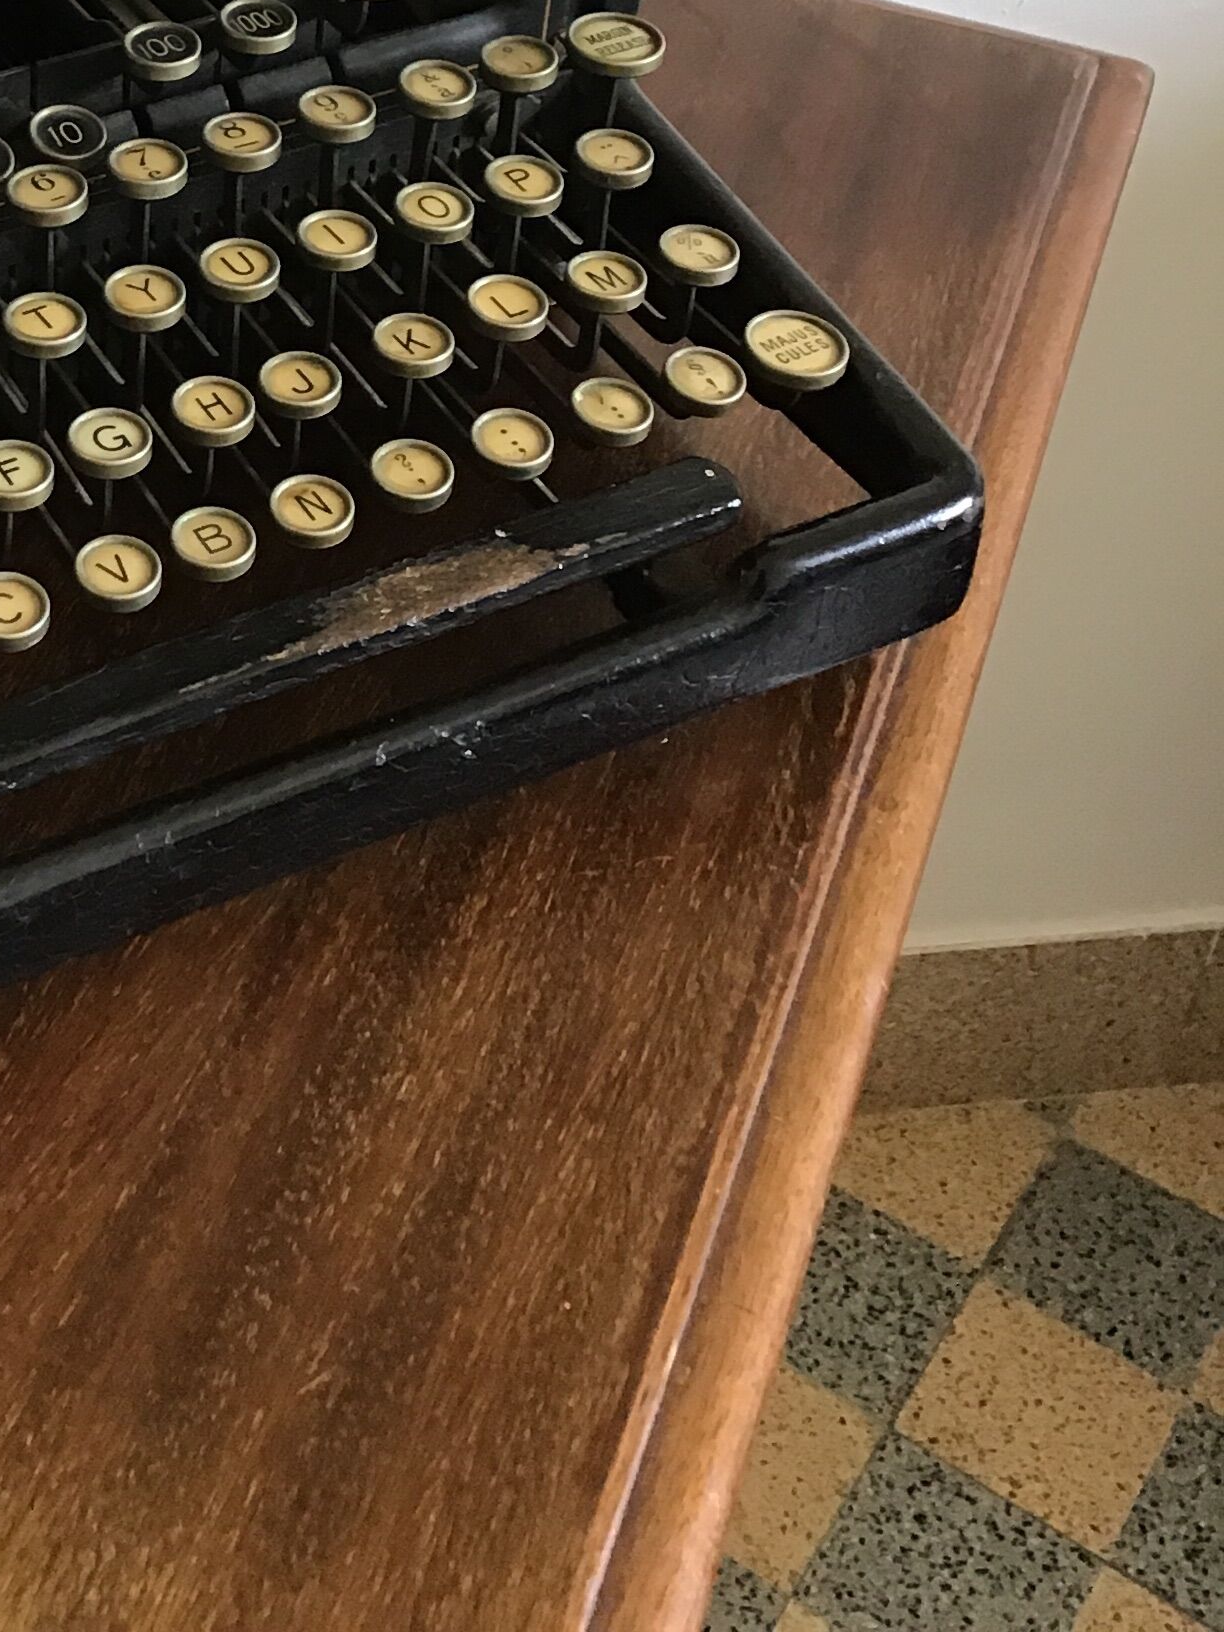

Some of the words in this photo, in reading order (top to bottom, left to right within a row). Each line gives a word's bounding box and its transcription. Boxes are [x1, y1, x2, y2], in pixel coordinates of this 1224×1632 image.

[137, 33, 187, 59] 100
[313, 94, 339, 112] 9
[47, 121, 84, 149] 10
[223, 121, 246, 139] 8
[126, 147, 147, 167] 7
[30, 172, 56, 192] 6
[503, 168, 531, 193] P
[416, 194, 451, 219] O
[321, 224, 346, 245] I
[219, 250, 256, 277] U
[125, 277, 157, 303] Y
[585, 265, 628, 292] M
[22, 305, 53, 330] T
[488, 295, 529, 319] L
[392, 328, 431, 355] K
[759, 325, 819, 353] MAJUS
[775, 337, 831, 365] CULES
[291, 368, 315, 395] J
[195, 391, 234, 422] H
[92, 424, 132, 453] G
[294, 490, 334, 521] N
[192, 522, 233, 555] B
[95, 552, 130, 584] V
